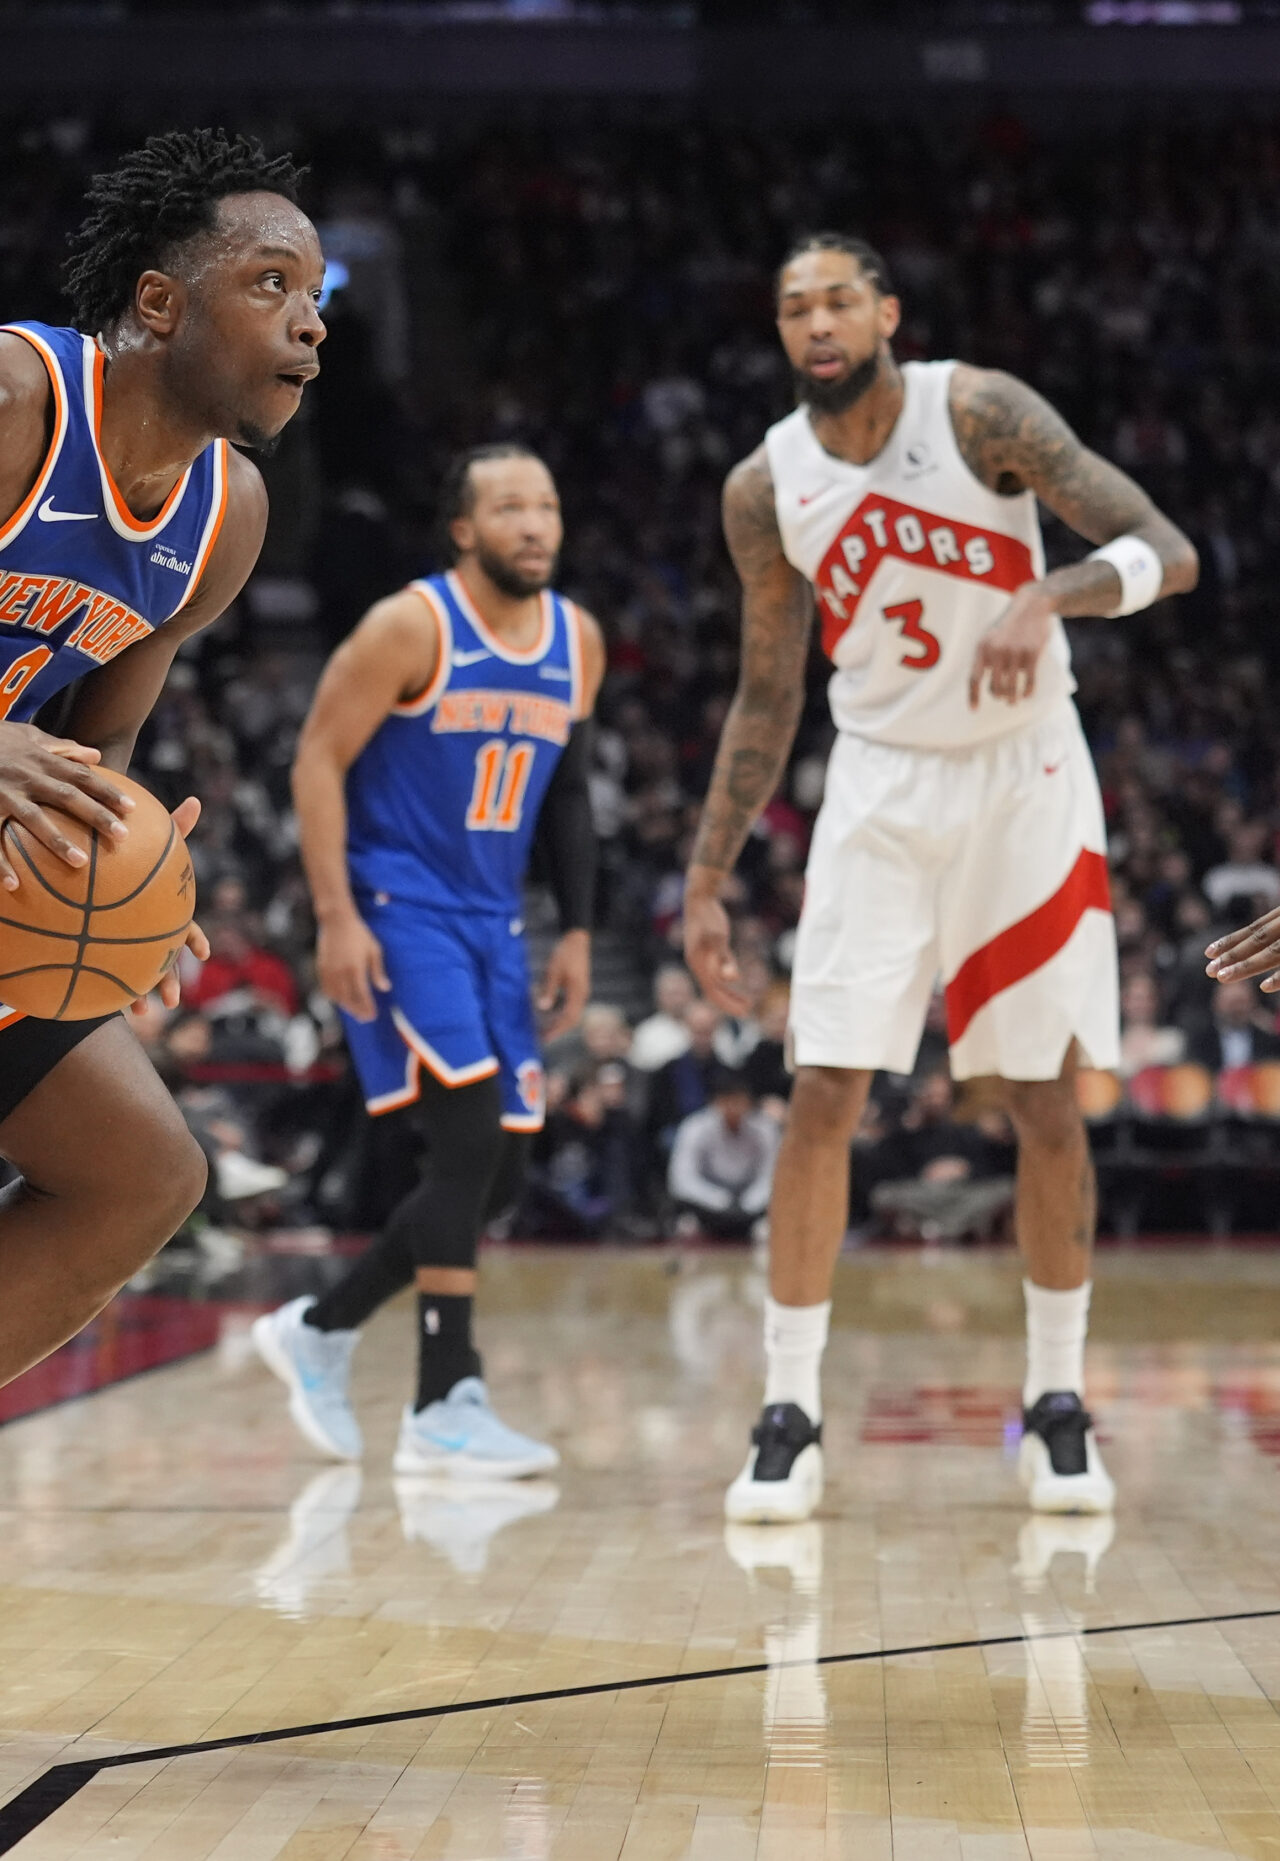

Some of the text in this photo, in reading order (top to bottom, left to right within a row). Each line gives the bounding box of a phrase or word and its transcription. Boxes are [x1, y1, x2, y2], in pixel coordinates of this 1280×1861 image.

[150, 551, 193, 575] abu dhabi
[63, 588, 156, 666] YORK
[881, 598, 942, 670] 3
[464, 738, 537, 832] 11
